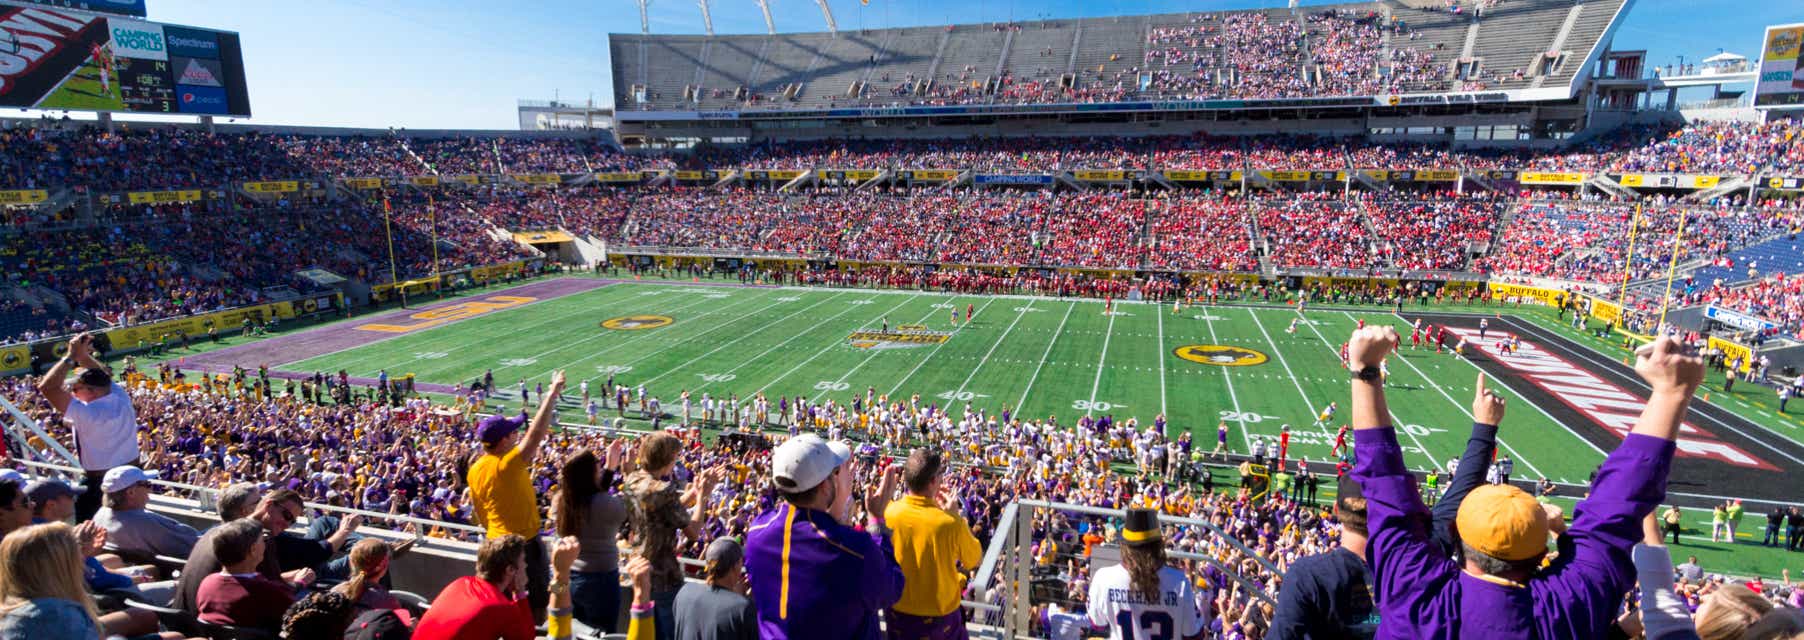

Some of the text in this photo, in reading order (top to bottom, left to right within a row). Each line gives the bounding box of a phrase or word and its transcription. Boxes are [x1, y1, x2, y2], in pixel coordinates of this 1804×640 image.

[112, 27, 162, 42] CAMPING
[115, 37, 164, 51] WORLD
[168, 35, 216, 49] Spectrum
[155, 61, 167, 72] 14
[162, 101, 170, 112] 3
[1509, 286, 1550, 298] BUFFALO
[352, 295, 539, 333] LSU
[813, 381, 850, 391] 50
[1071, 399, 1111, 411] 30
[1218, 410, 1263, 423] 20
[1164, 591, 1178, 607] JR
